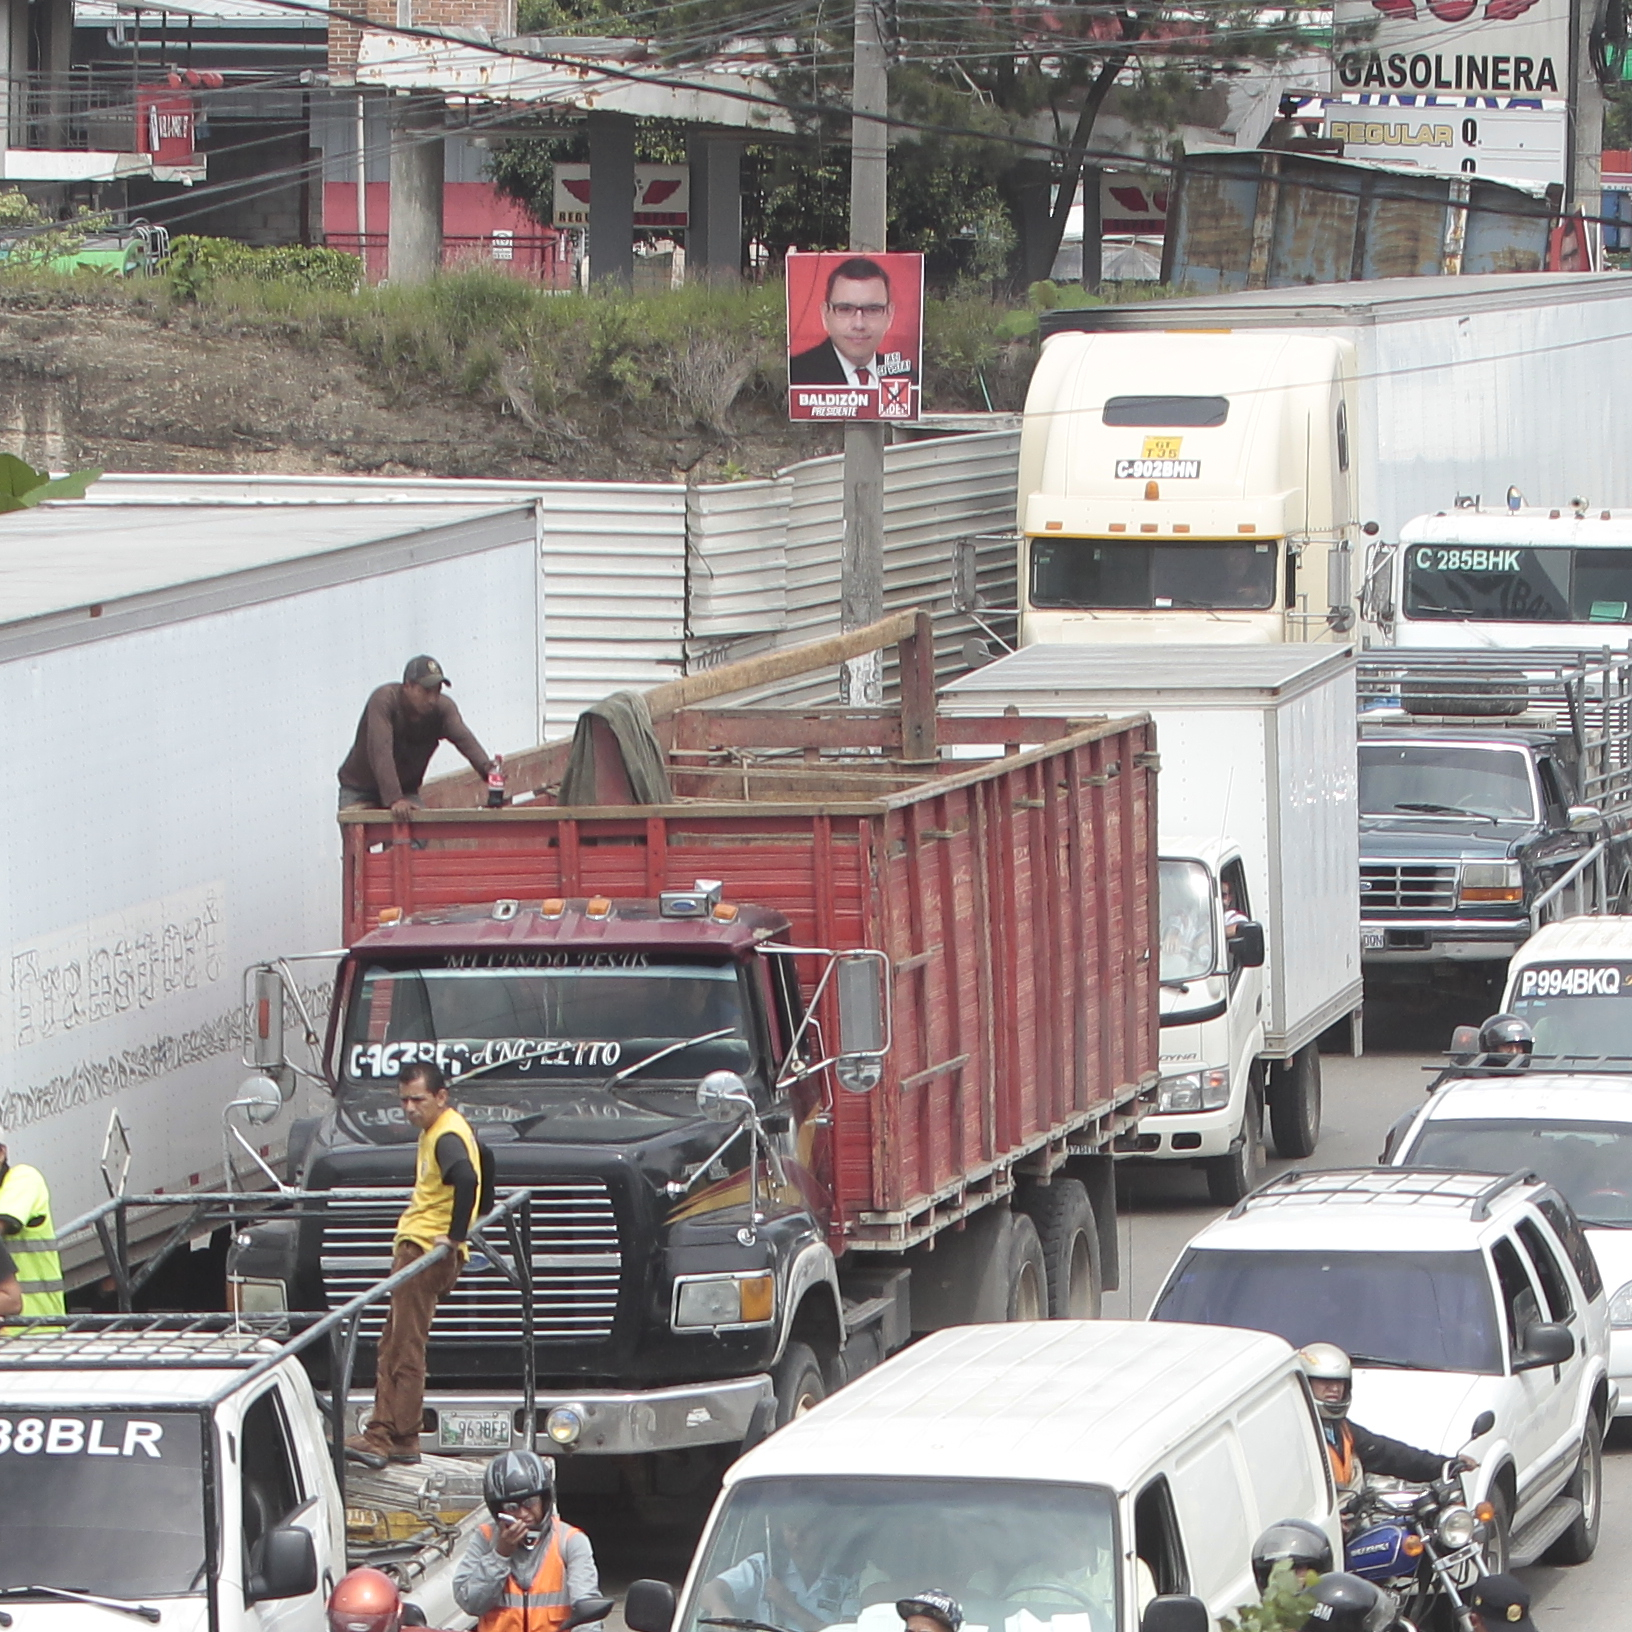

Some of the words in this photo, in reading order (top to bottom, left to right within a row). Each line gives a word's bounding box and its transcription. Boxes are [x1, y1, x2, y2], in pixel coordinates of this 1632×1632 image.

[1339, 53, 1558, 92] GASOLINERA
[1331, 121, 1454, 148] REGULAR
[799, 391, 869, 407] BALDIZÓN
[811, 406, 858, 417] PRESIDENTE
[1117, 461, 1199, 478] C-902BHN
[1416, 548, 1433, 569] C
[1437, 549, 1521, 572] 285BHK
[1521, 967, 1620, 997] P994BKQ
